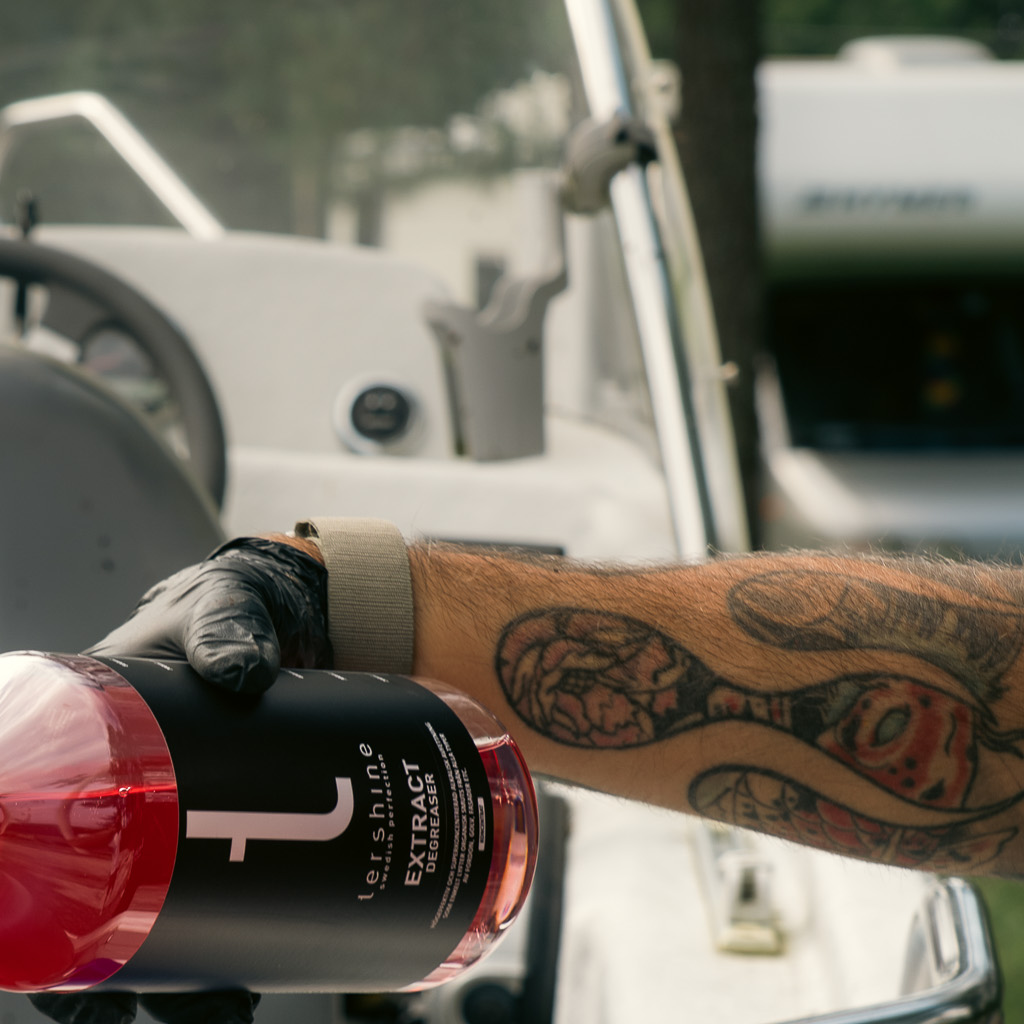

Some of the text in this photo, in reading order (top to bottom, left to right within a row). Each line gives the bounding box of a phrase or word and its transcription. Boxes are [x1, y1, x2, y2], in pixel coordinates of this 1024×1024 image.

[357, 742, 386, 901] tershine
[377, 753, 396, 890] swedish perfection
[401, 758, 427, 886] EXTRACT
[425, 773, 440, 873] DEGREASER
